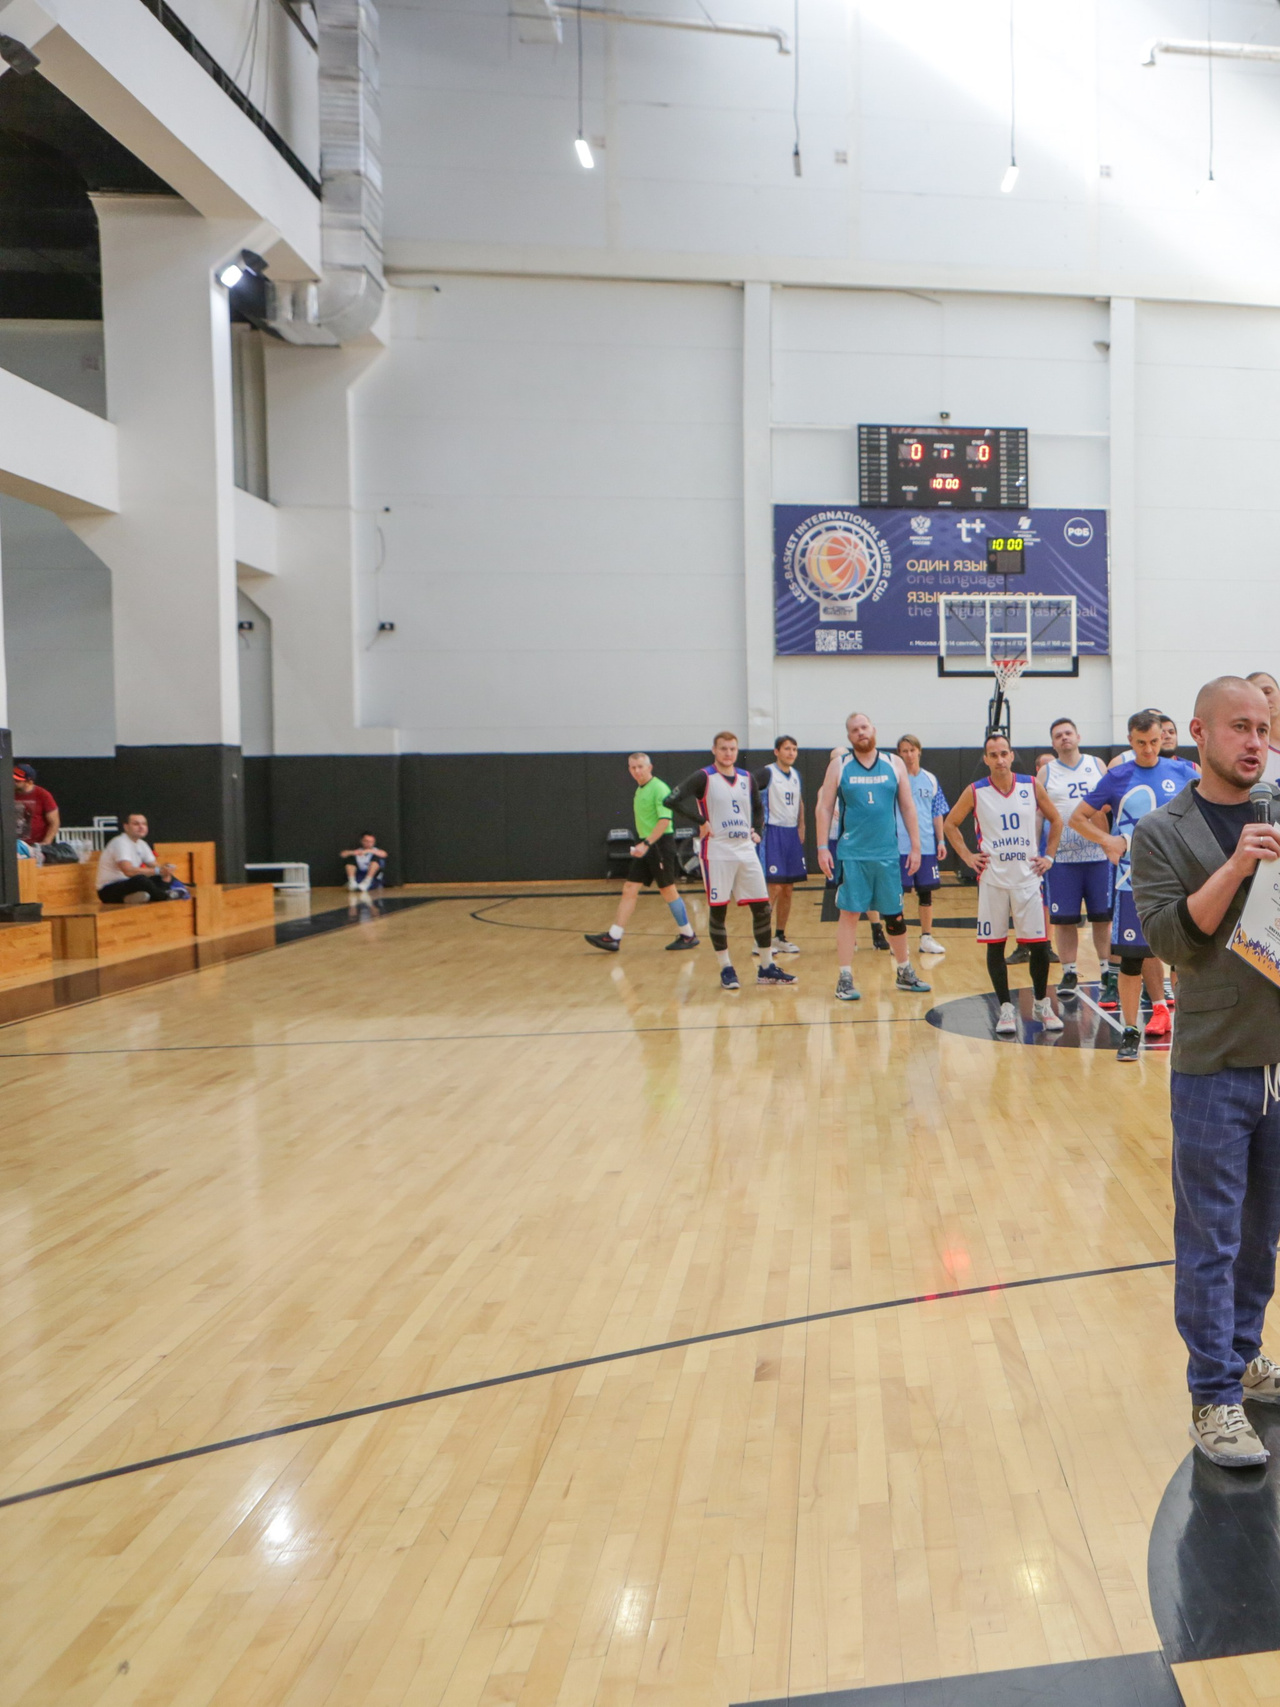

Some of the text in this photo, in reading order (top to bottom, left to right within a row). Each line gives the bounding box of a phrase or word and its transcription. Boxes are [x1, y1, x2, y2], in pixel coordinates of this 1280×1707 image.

[911, 444, 922, 460] 0
[978, 445, 990, 461] 0
[795, 511, 880, 540] INTERNATIONAL
[1067, 527, 1090, 537] РФБ
[877, 539, 892, 578] SUPER
[906, 560, 950, 573] ОДИН
[906, 575, 935, 584] one
[939, 573, 1005, 588] language
[871, 579, 888, 602] CUP
[907, 605, 931, 616] the
[838, 630, 863, 641] ВСЕ
[867, 791, 875, 804] 1
[1067, 782, 1089, 799] 25
[785, 792, 794, 806] 91
[732, 800, 740, 814] 5
[722, 819, 749, 829] ВНИИ
[1000, 812, 1020, 831] 10
[992, 836, 1031, 849] ВНИИЭФ
[1000, 852, 1027, 862] САРОВ
[711, 888, 718, 900] 5
